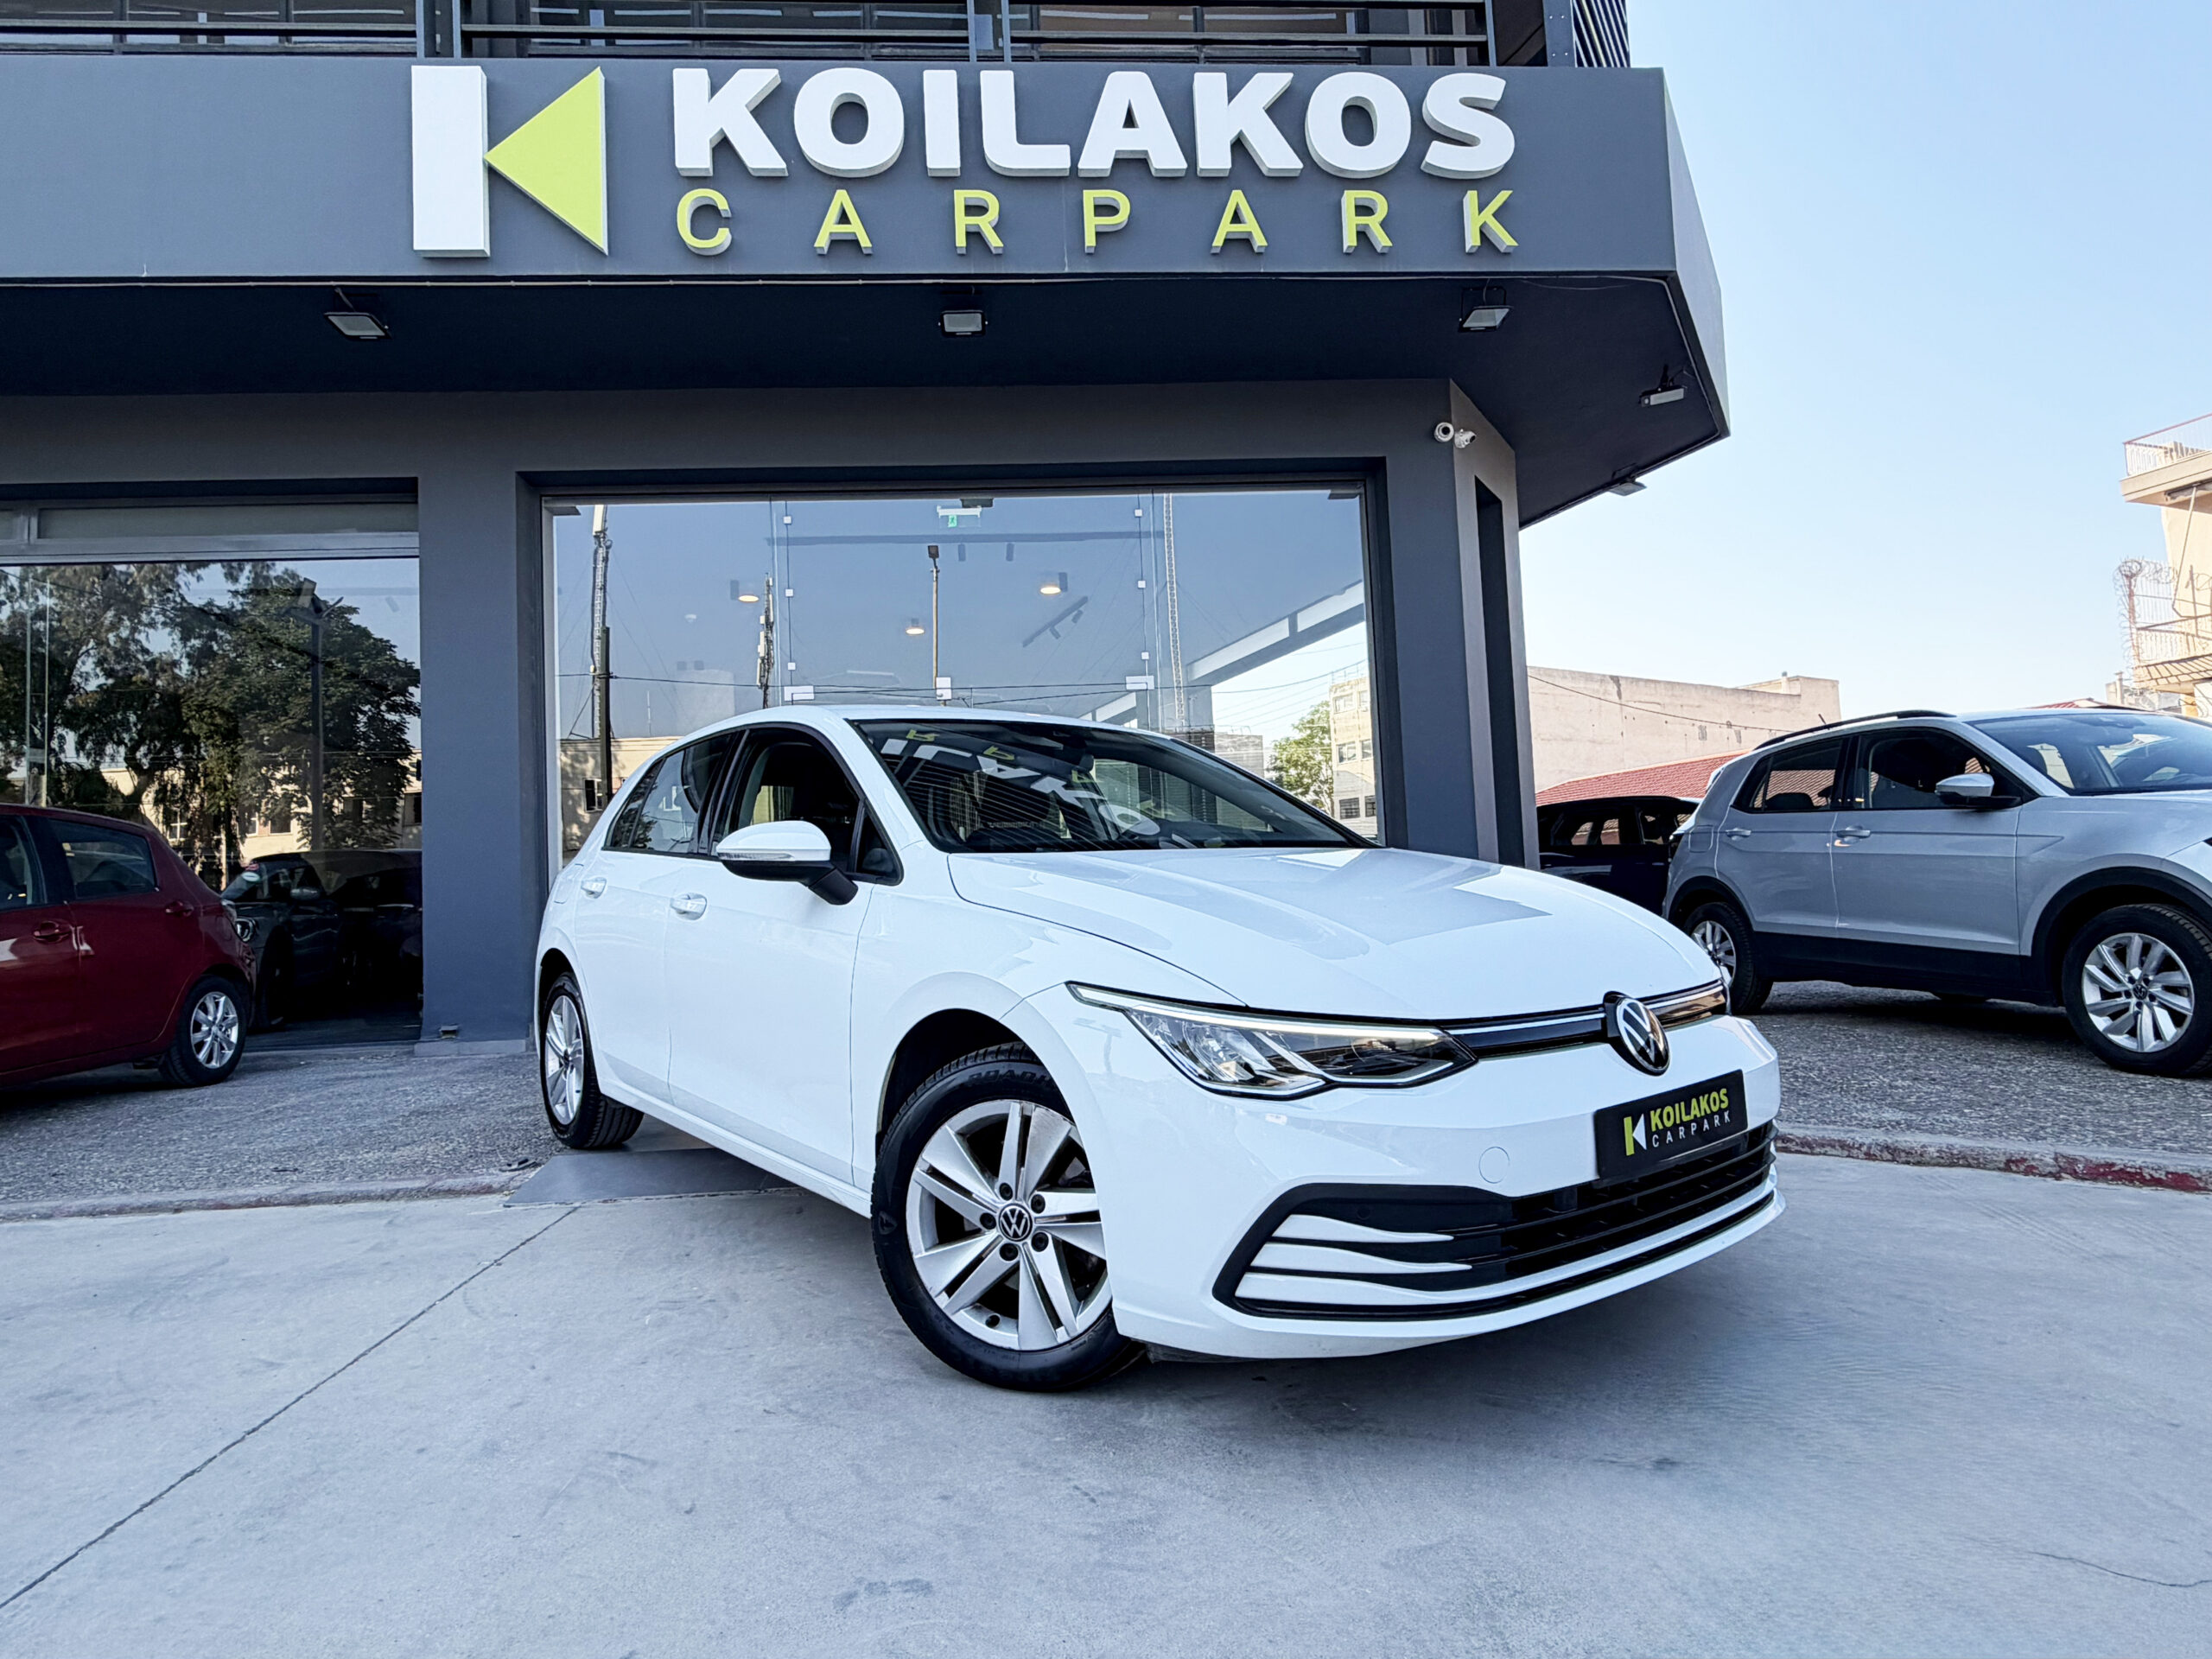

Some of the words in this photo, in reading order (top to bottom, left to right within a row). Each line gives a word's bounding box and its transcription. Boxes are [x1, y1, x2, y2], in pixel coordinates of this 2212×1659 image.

[673, 67, 1515, 178] KOILAKOS
[677, 188, 1518, 254] CARPARK
[1649, 1088, 1729, 1132] KOILAKOS
[1652, 1110, 1731, 1147] CARPARK
